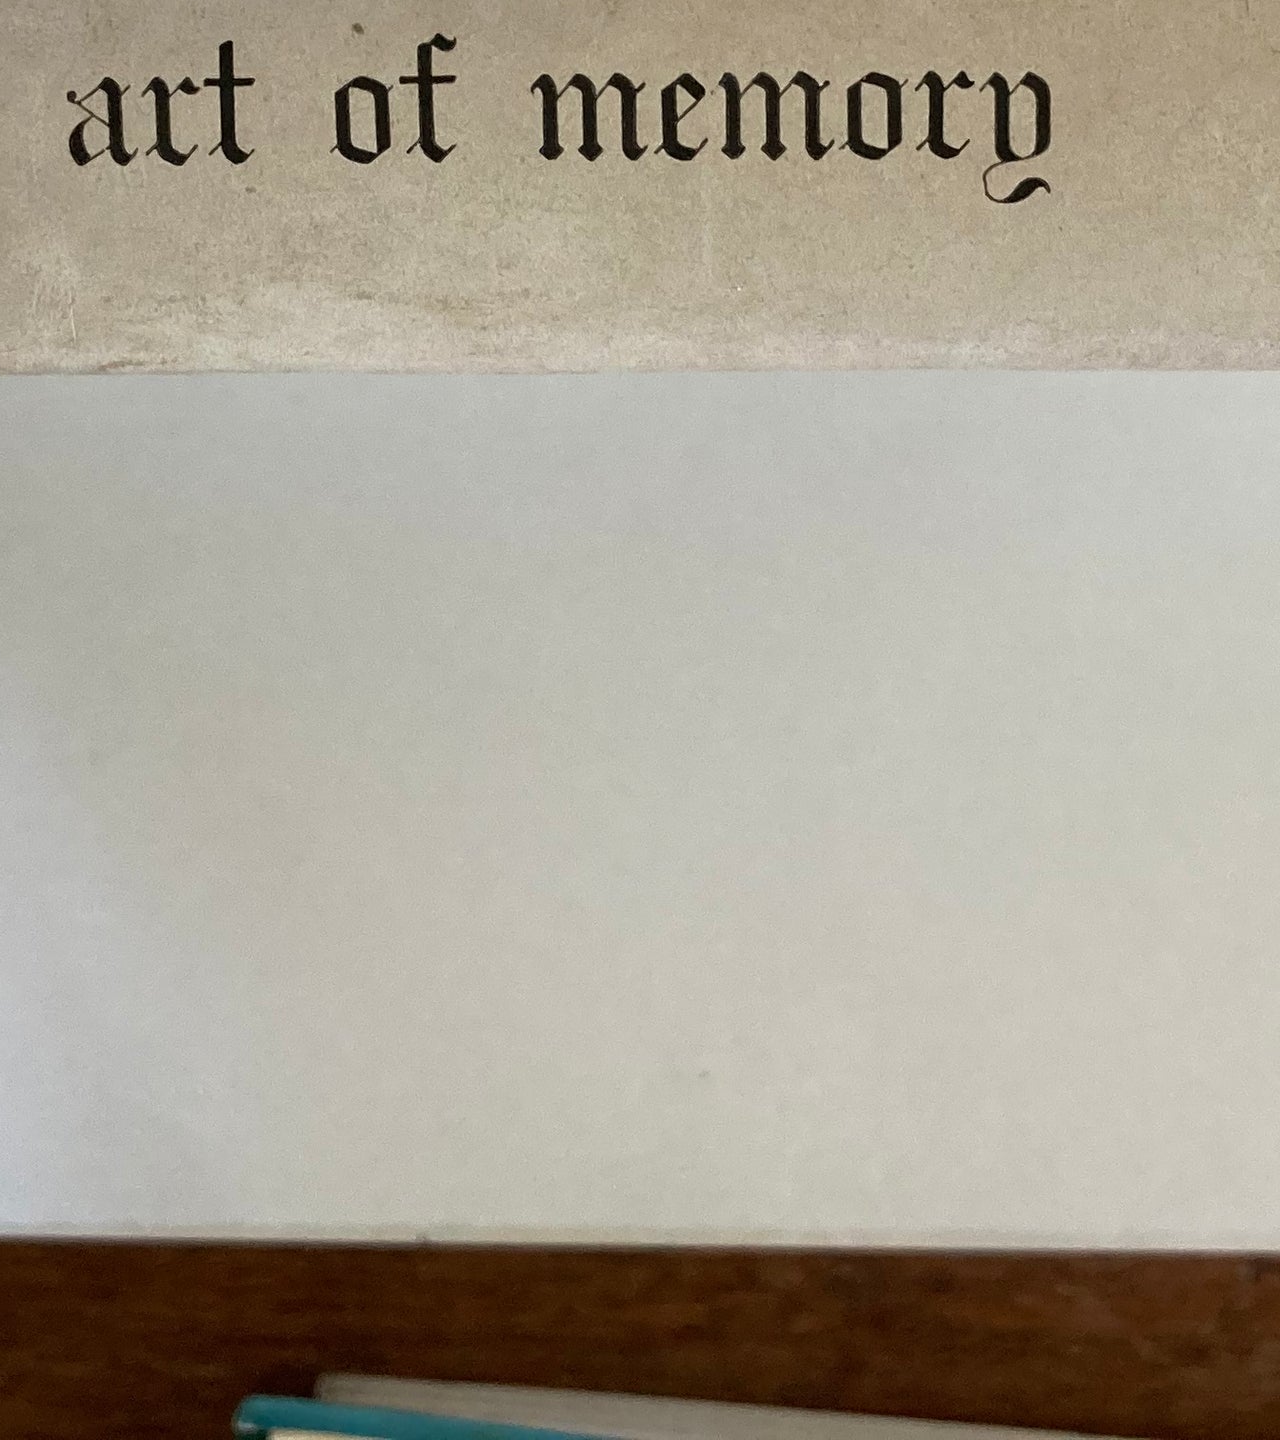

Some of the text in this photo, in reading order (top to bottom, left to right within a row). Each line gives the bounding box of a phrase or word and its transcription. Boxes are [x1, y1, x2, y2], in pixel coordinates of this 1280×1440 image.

[66, 39, 256, 167] art
[329, 32, 458, 165] of
[530, 69, 1053, 204] memory
